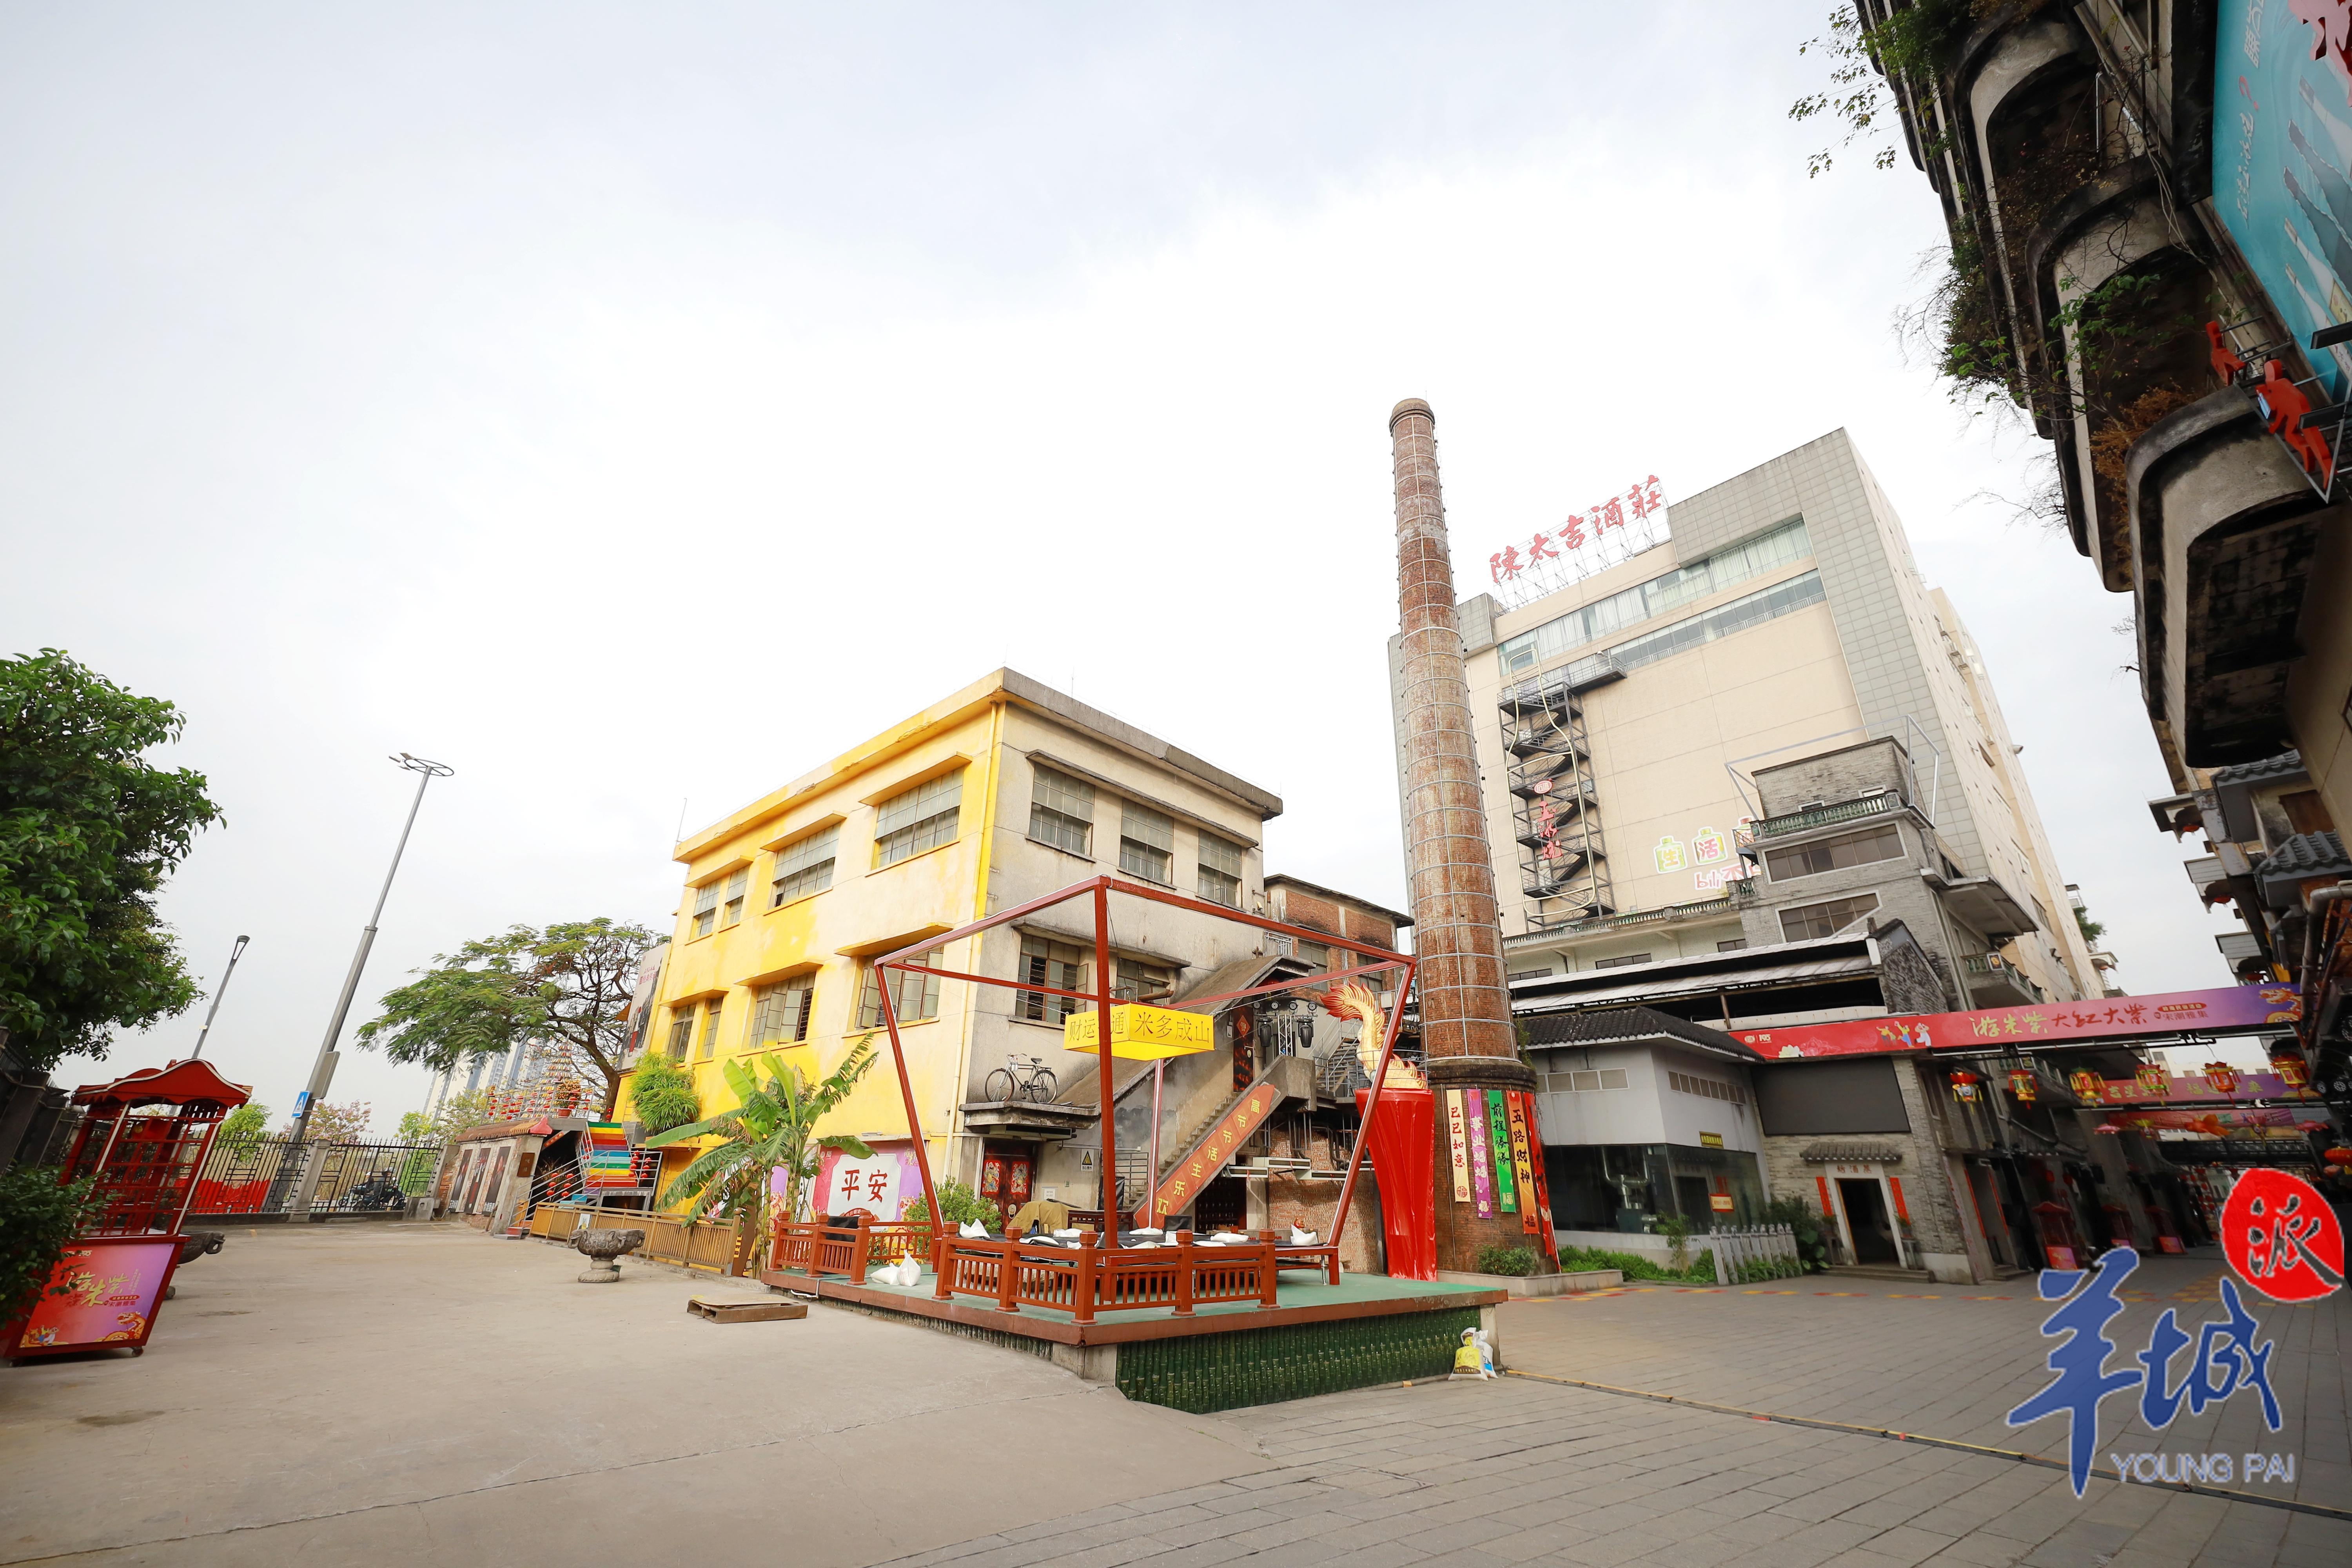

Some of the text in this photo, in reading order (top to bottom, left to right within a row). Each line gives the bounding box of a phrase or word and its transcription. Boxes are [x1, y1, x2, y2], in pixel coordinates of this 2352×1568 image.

[1490, 475, 1661, 583] 陳太吉酒莊
[1069, 1012, 1124, 1042] 财运通
[1135, 1011, 1210, 1044] 米多成山
[2051, 1003, 2147, 1027] 大红大紫
[1156, 1099, 1261, 1216] 欢乐生活节节高
[1512, 1109, 1530, 1183] 五路财神
[842, 1169, 887, 1203] 平安
[1503, 1192, 1513, 1205] 福
[1524, 1215, 1535, 1227] 福
